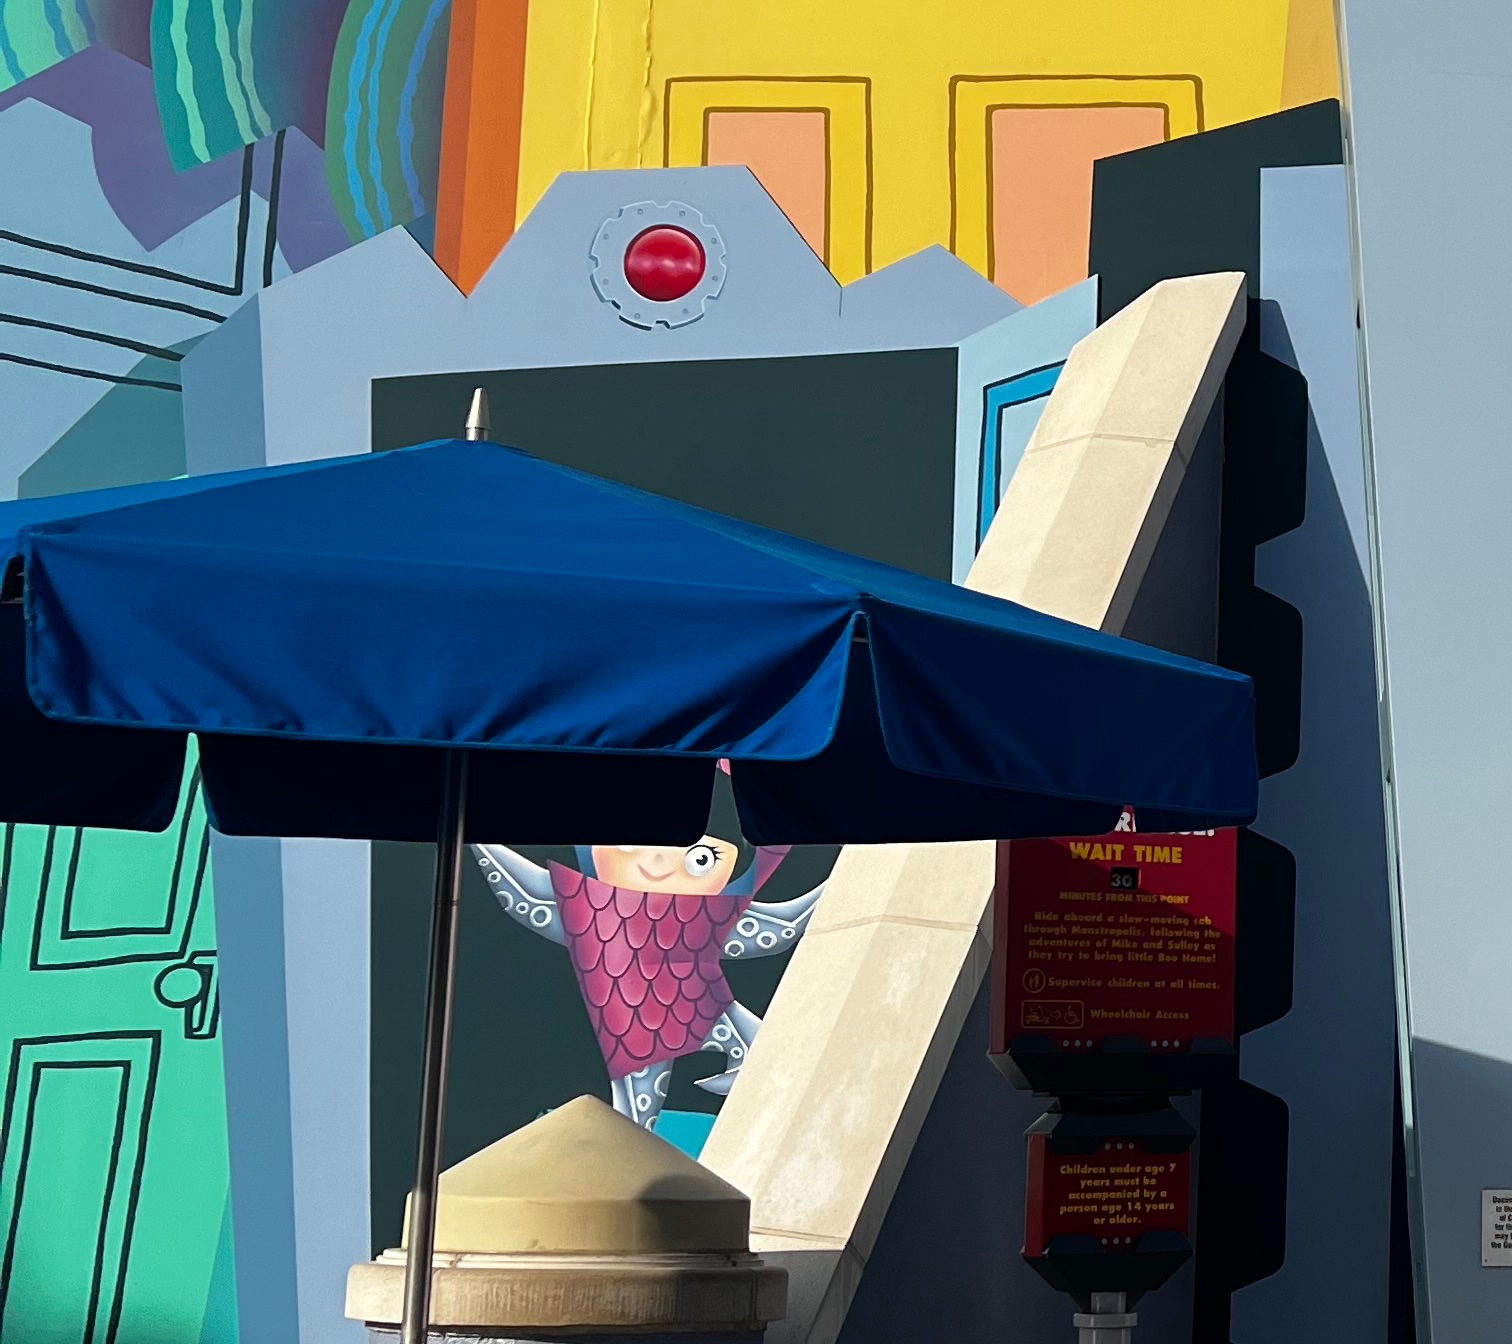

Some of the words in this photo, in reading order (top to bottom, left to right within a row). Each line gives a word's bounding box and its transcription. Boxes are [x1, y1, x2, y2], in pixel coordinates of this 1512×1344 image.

[1069, 842, 1124, 861] WAIT
[1133, 845, 1183, 863] TIME
[1111, 874, 1132, 887] 30
[1059, 891, 1102, 901] MINUTES
[1105, 893, 1133, 902] FROM
[1136, 894, 1158, 903] THIS
[1160, 895, 1190, 904] POINT
[1034, 911, 1059, 921] Ride
[1064, 913, 1103, 922] aboard
[1119, 914, 1190, 926] slow-moving
[1194, 915, 1211, 926] cab
[1024, 924, 1067, 936] through
[1150, 927, 1200, 939] following
[1204, 929, 1221, 938] the
[1029, 937, 1091, 947] adventures
[1096, 939, 1107, 947] of
[1112, 939, 1138, 948] Mike
[1143, 940, 1163, 949] and
[1167, 940, 1200, 952] Sulley
[1028, 950, 1052, 961] they
[1057, 950, 1074, 961] try
[1079, 951, 1089, 960] to
[1094, 951, 1124, 964] bring
[1127, 951, 1153, 962] little
[1158, 953, 1178, 962] Boo
[1048, 977, 1102, 989] Supervise
[1108, 978, 1150, 989] children
[1154, 980, 1166, 988] at
[1170, 979, 1183, 989] all
[1188, 979, 1221, 989] times.
[1090, 1009, 1151, 1019] Wheelchair
[1156, 1010, 1190, 1020] Access
[1060, 1164, 1106, 1174] Children
[1110, 1164, 1141, 1173] under
[1145, 1166, 1165, 1175] age
[1169, 1163, 1176, 1172] 7
[1080, 1178, 1110, 1189] years
[1114, 1178, 1140, 1186] must
[1143, 1176, 1157, 1185] be
[1068, 1189, 1140, 1201] accompanied
[1144, 1189, 1157, 1199] by
[1059, 1204, 1098, 1215] person
[1102, 1204, 1122, 1214] age
[1127, 1202, 1141, 1211] 14
[1145, 1202, 1174, 1213] years
[1093, 1216, 1105, 1224] or
[1109, 1214, 1141, 1224] older.
